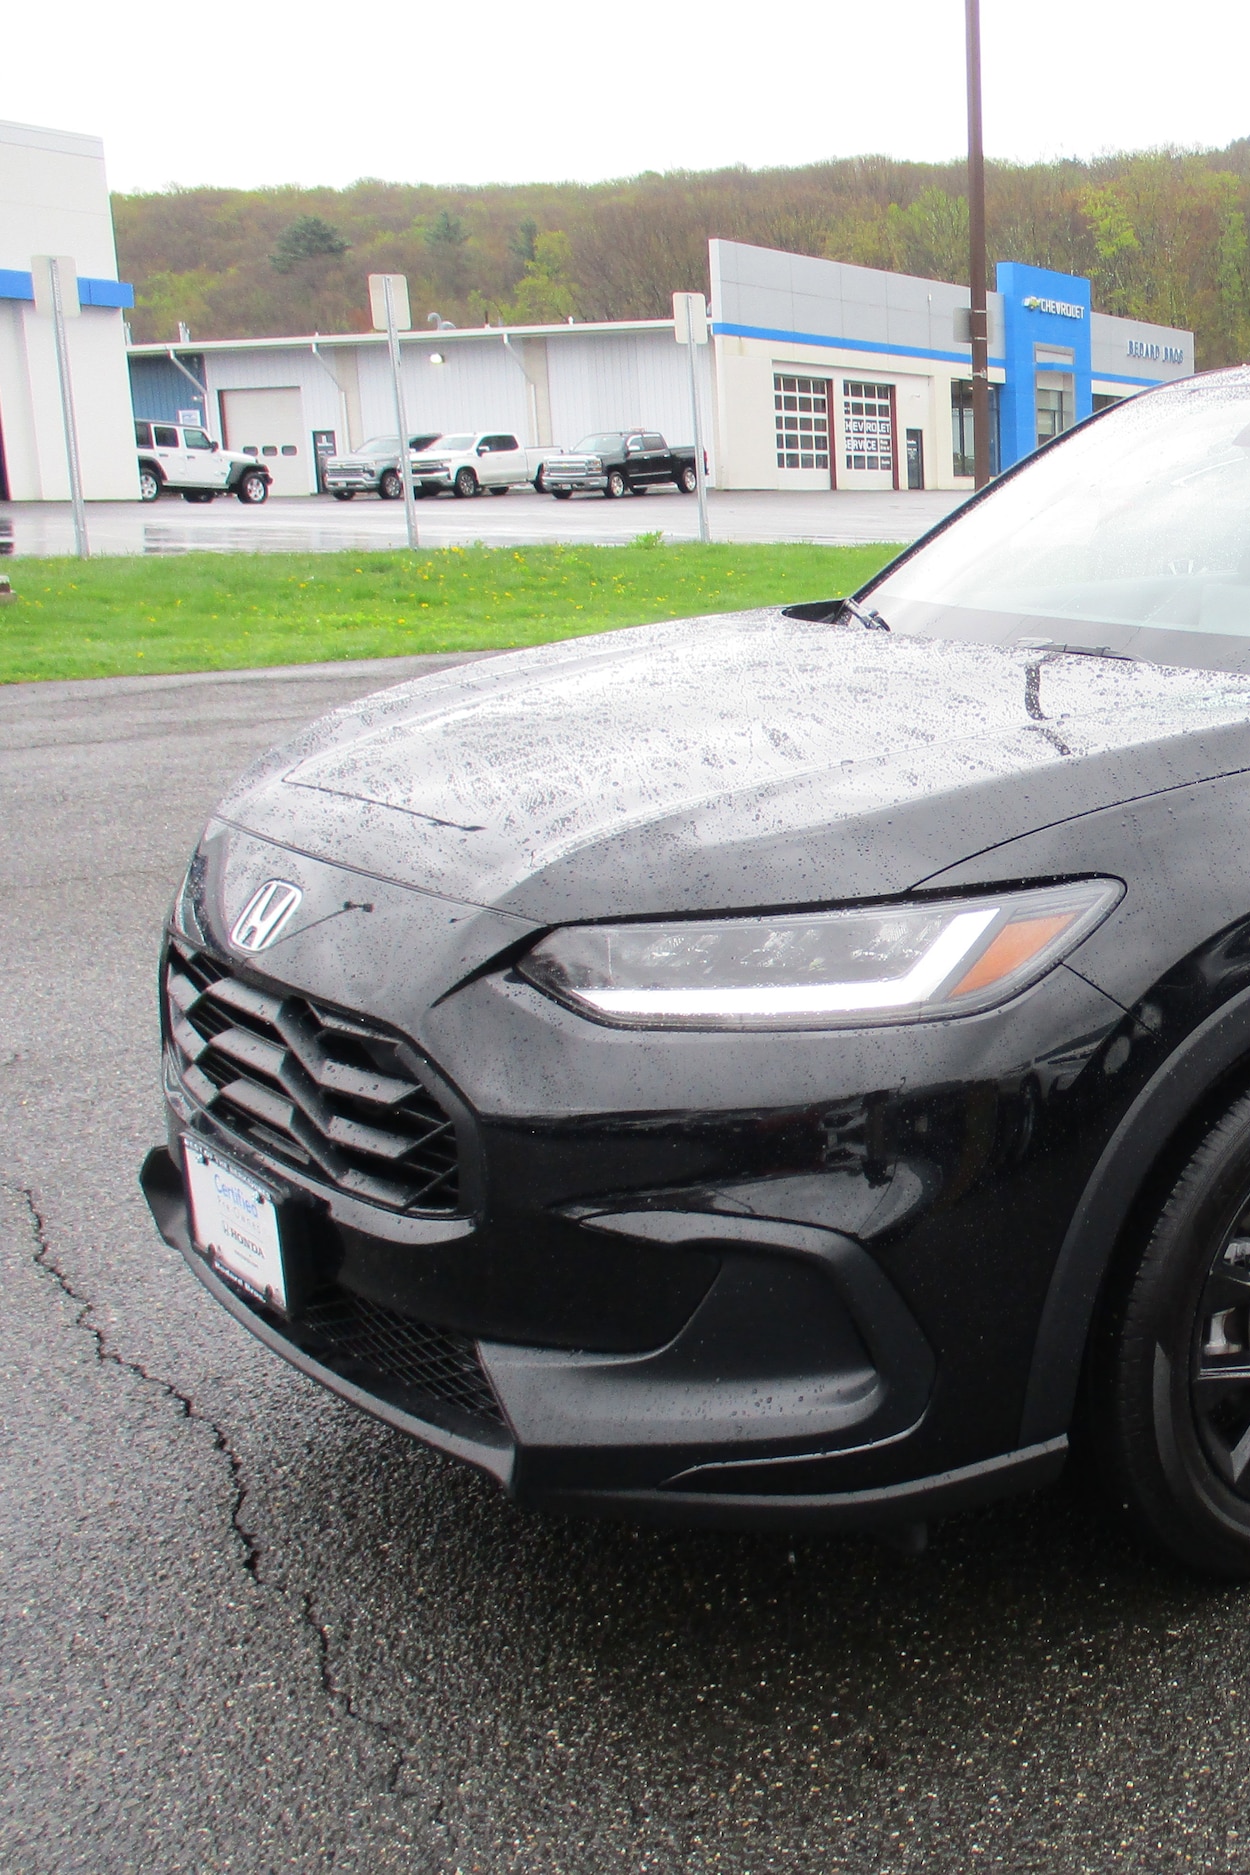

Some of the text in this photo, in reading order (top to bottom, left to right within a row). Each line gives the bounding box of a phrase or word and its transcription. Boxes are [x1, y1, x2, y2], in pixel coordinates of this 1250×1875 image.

[1040, 298, 1085, 319] CHEVROLET
[1127, 340, 1184, 364] BEDARD BROS
[845, 420, 890, 433] HEVROLET
